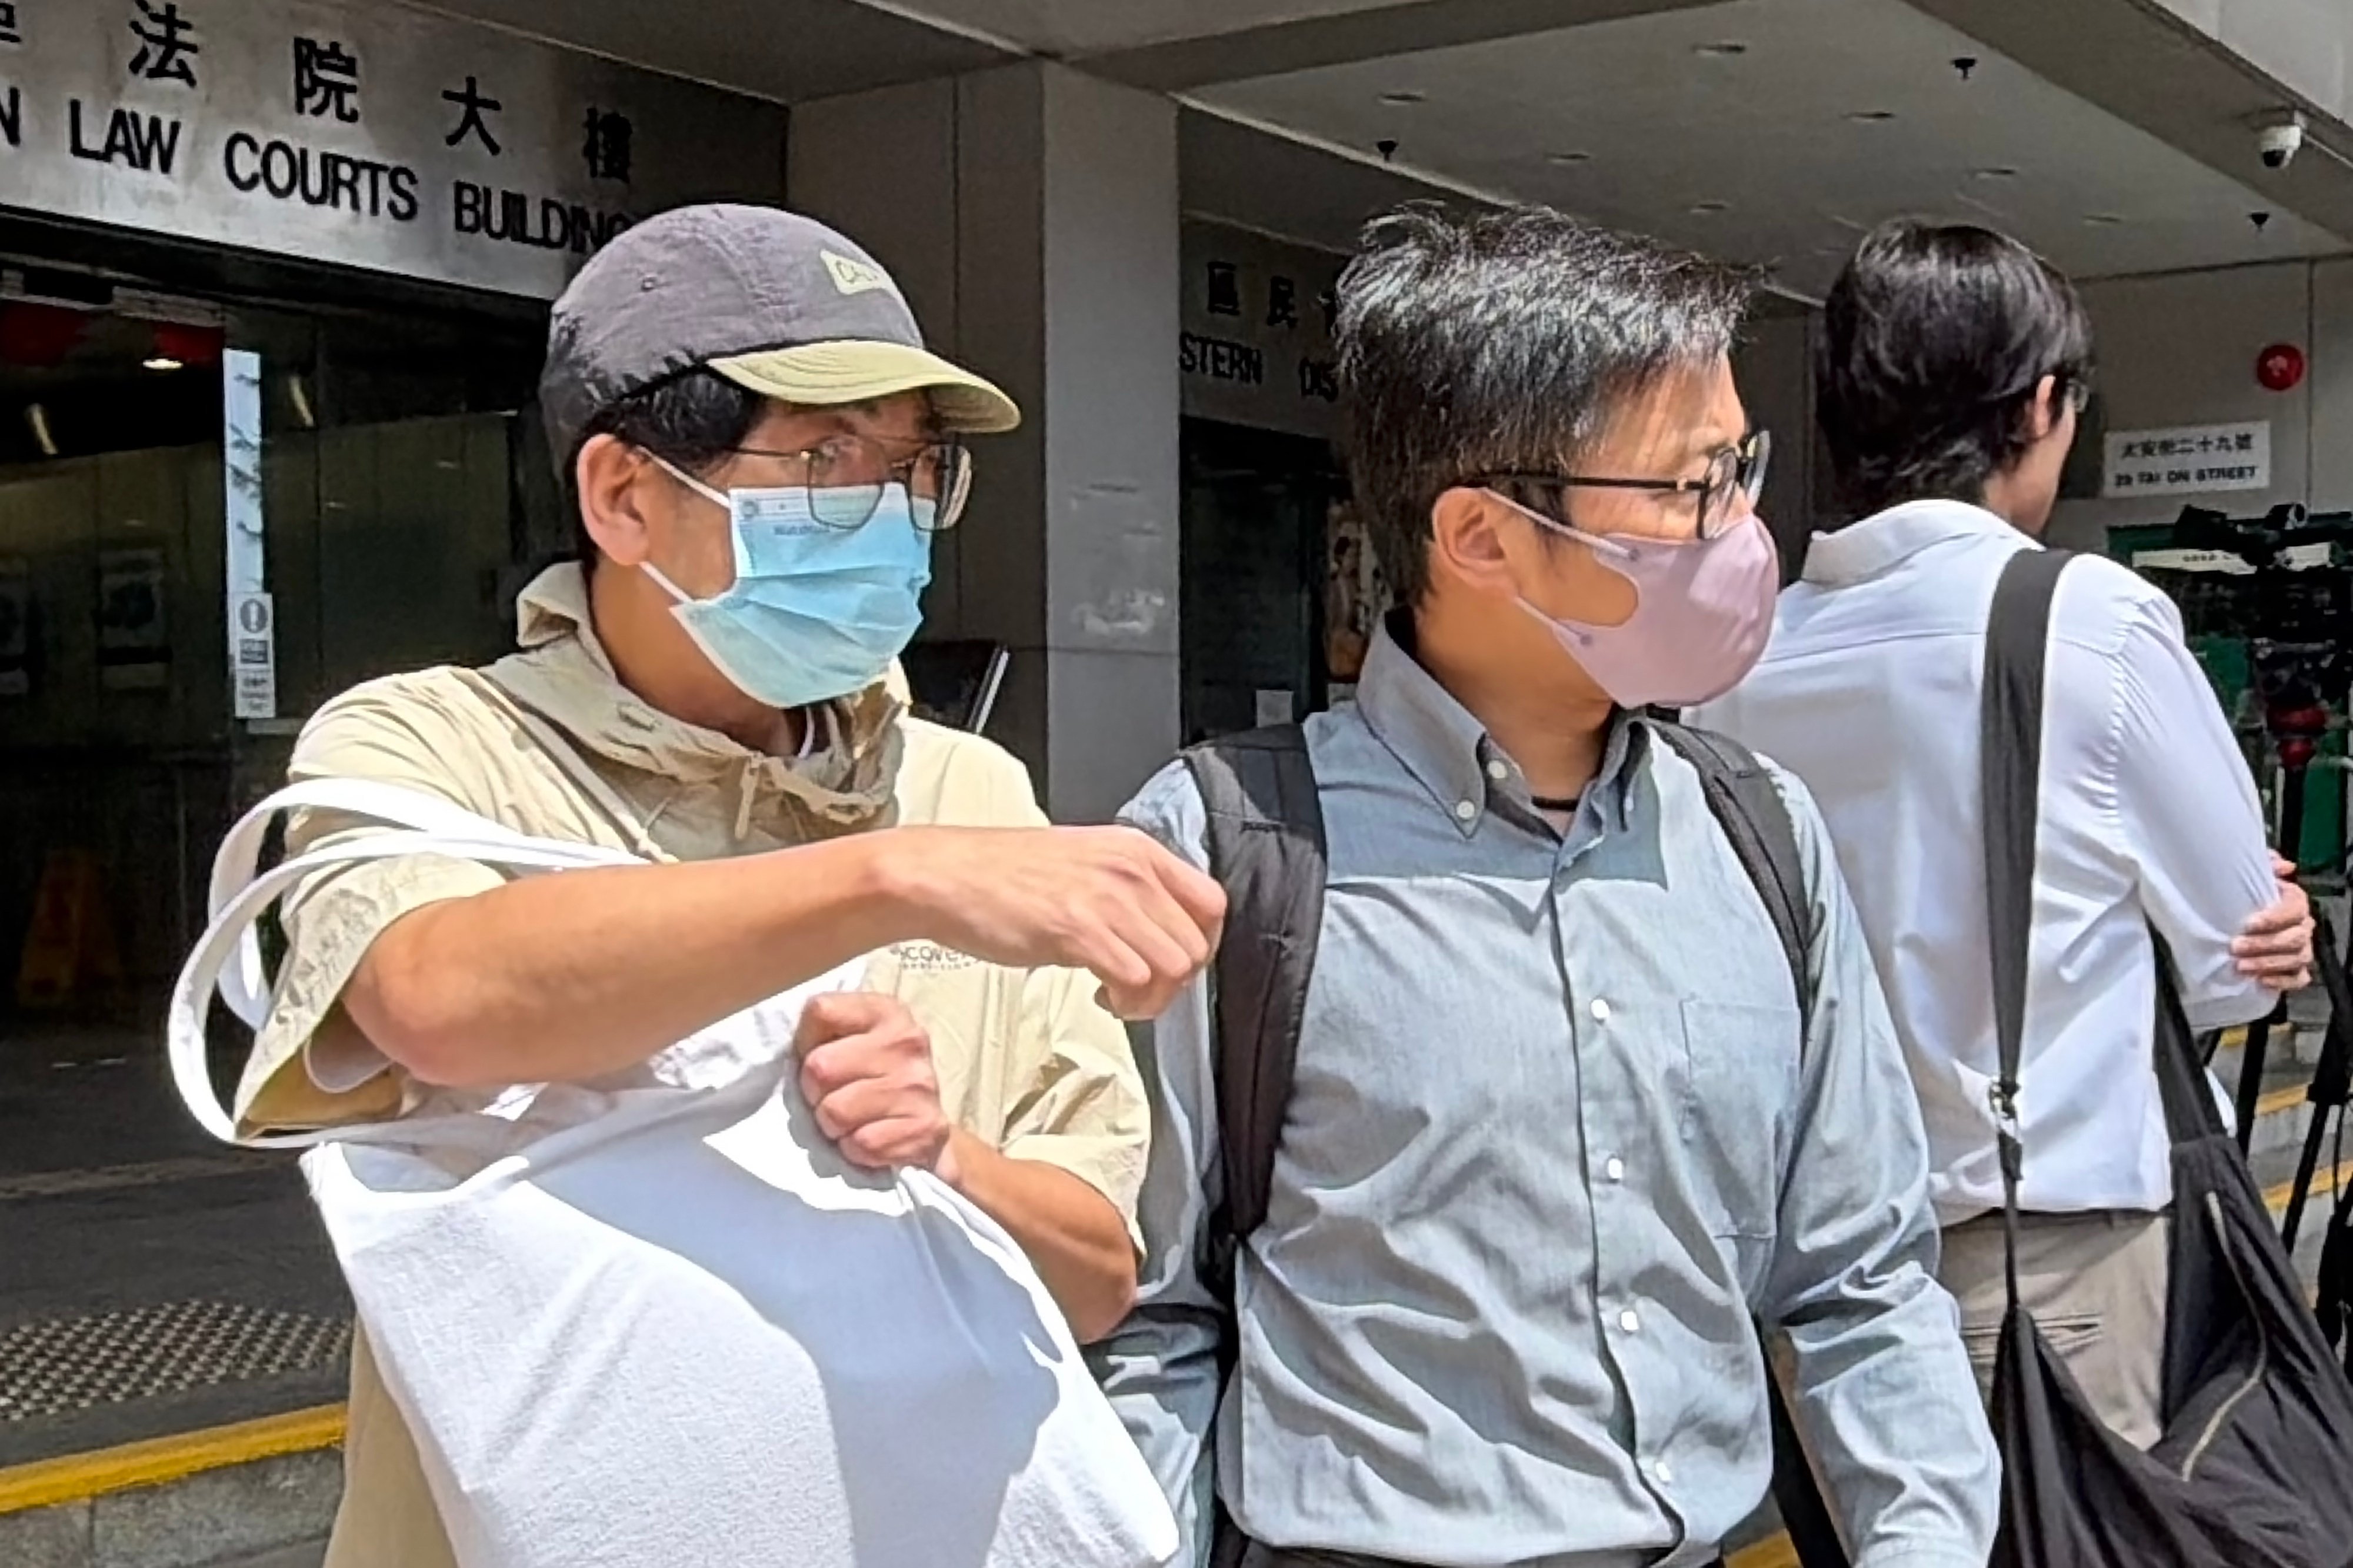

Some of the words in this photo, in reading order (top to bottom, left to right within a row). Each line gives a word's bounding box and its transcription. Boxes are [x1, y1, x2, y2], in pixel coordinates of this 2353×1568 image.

[69, 98, 181, 174] LAW
[224, 131, 418, 221] COURTS
[2196, 466, 2258, 482] STREET
